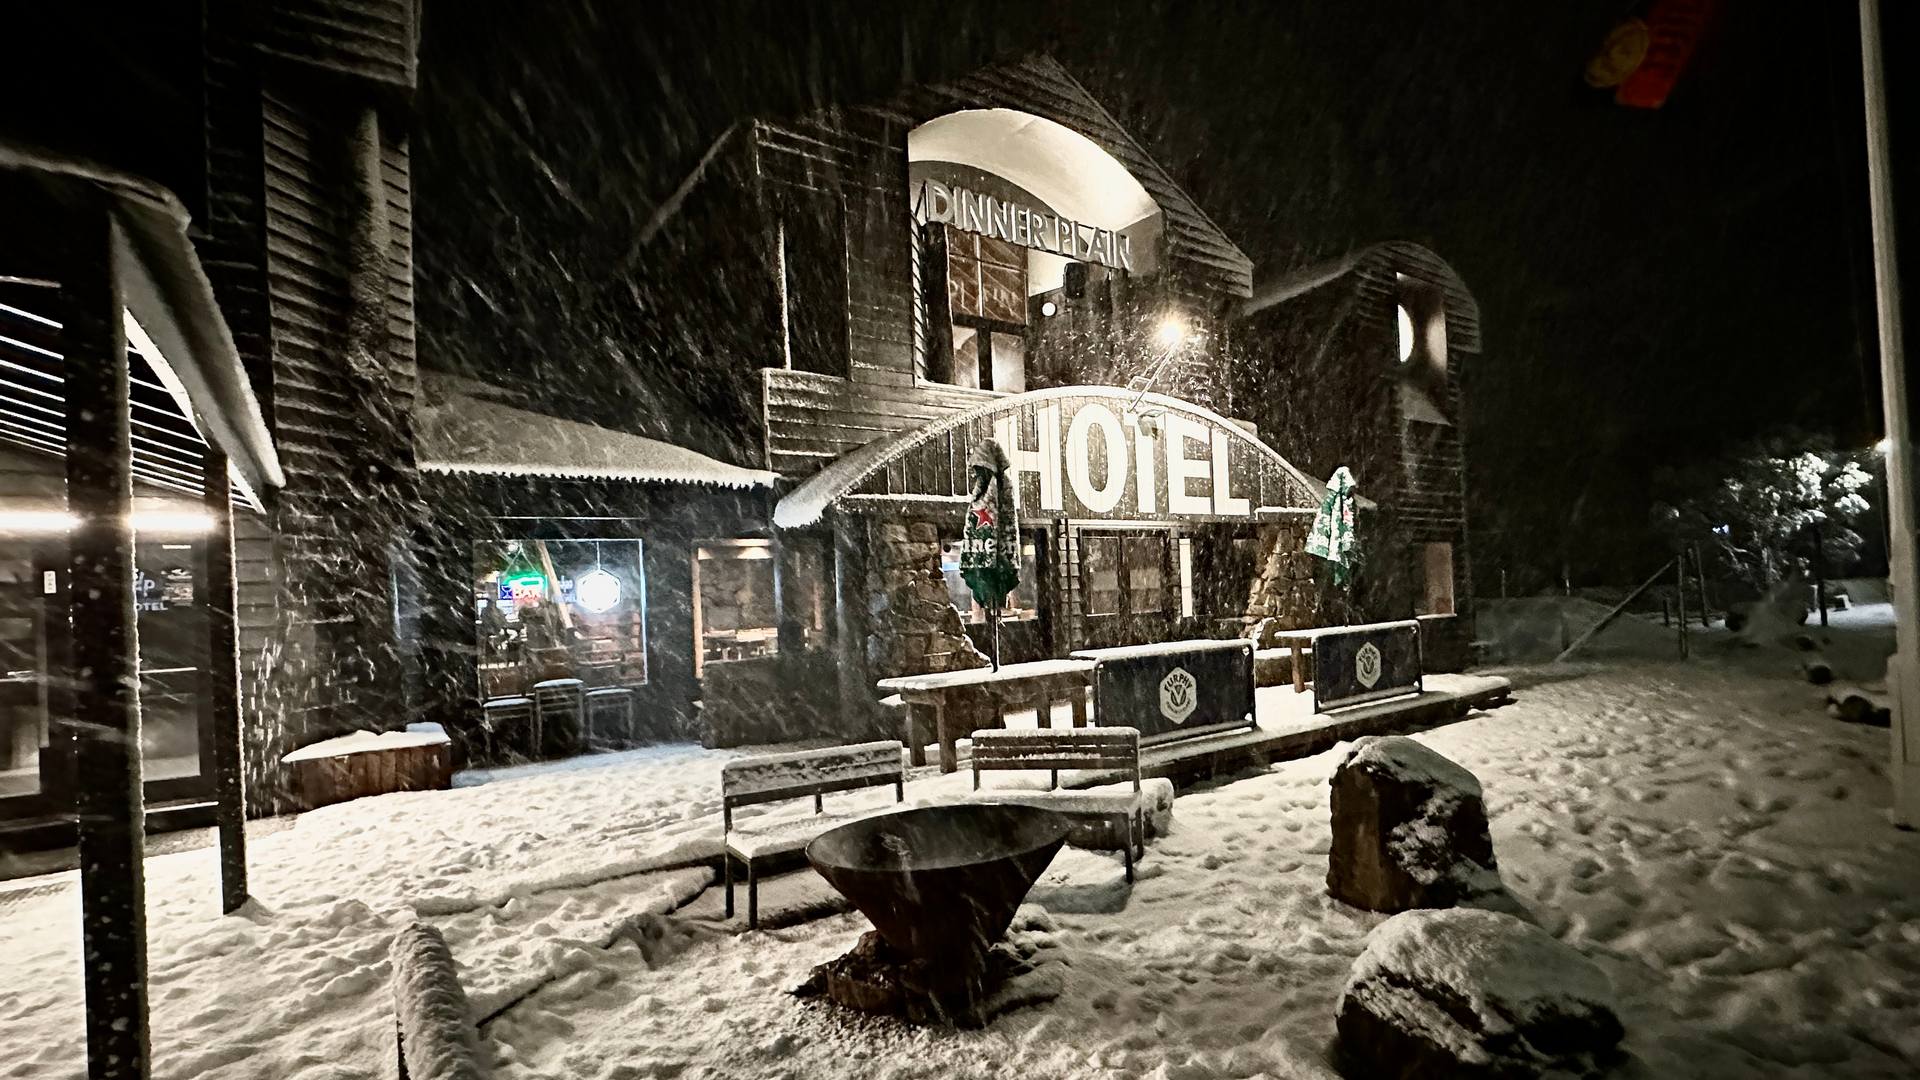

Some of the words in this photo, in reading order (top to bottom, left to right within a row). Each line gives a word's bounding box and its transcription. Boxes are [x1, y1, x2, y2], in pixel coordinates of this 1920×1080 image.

[925, 178, 1048, 251] DINNER
[1055, 215, 1133, 272] PLAIN
[995, 403, 1250, 516] HOTEL
[136, 602, 169, 611] OTEL
[1164, 673, 1193, 693] FURPHY
